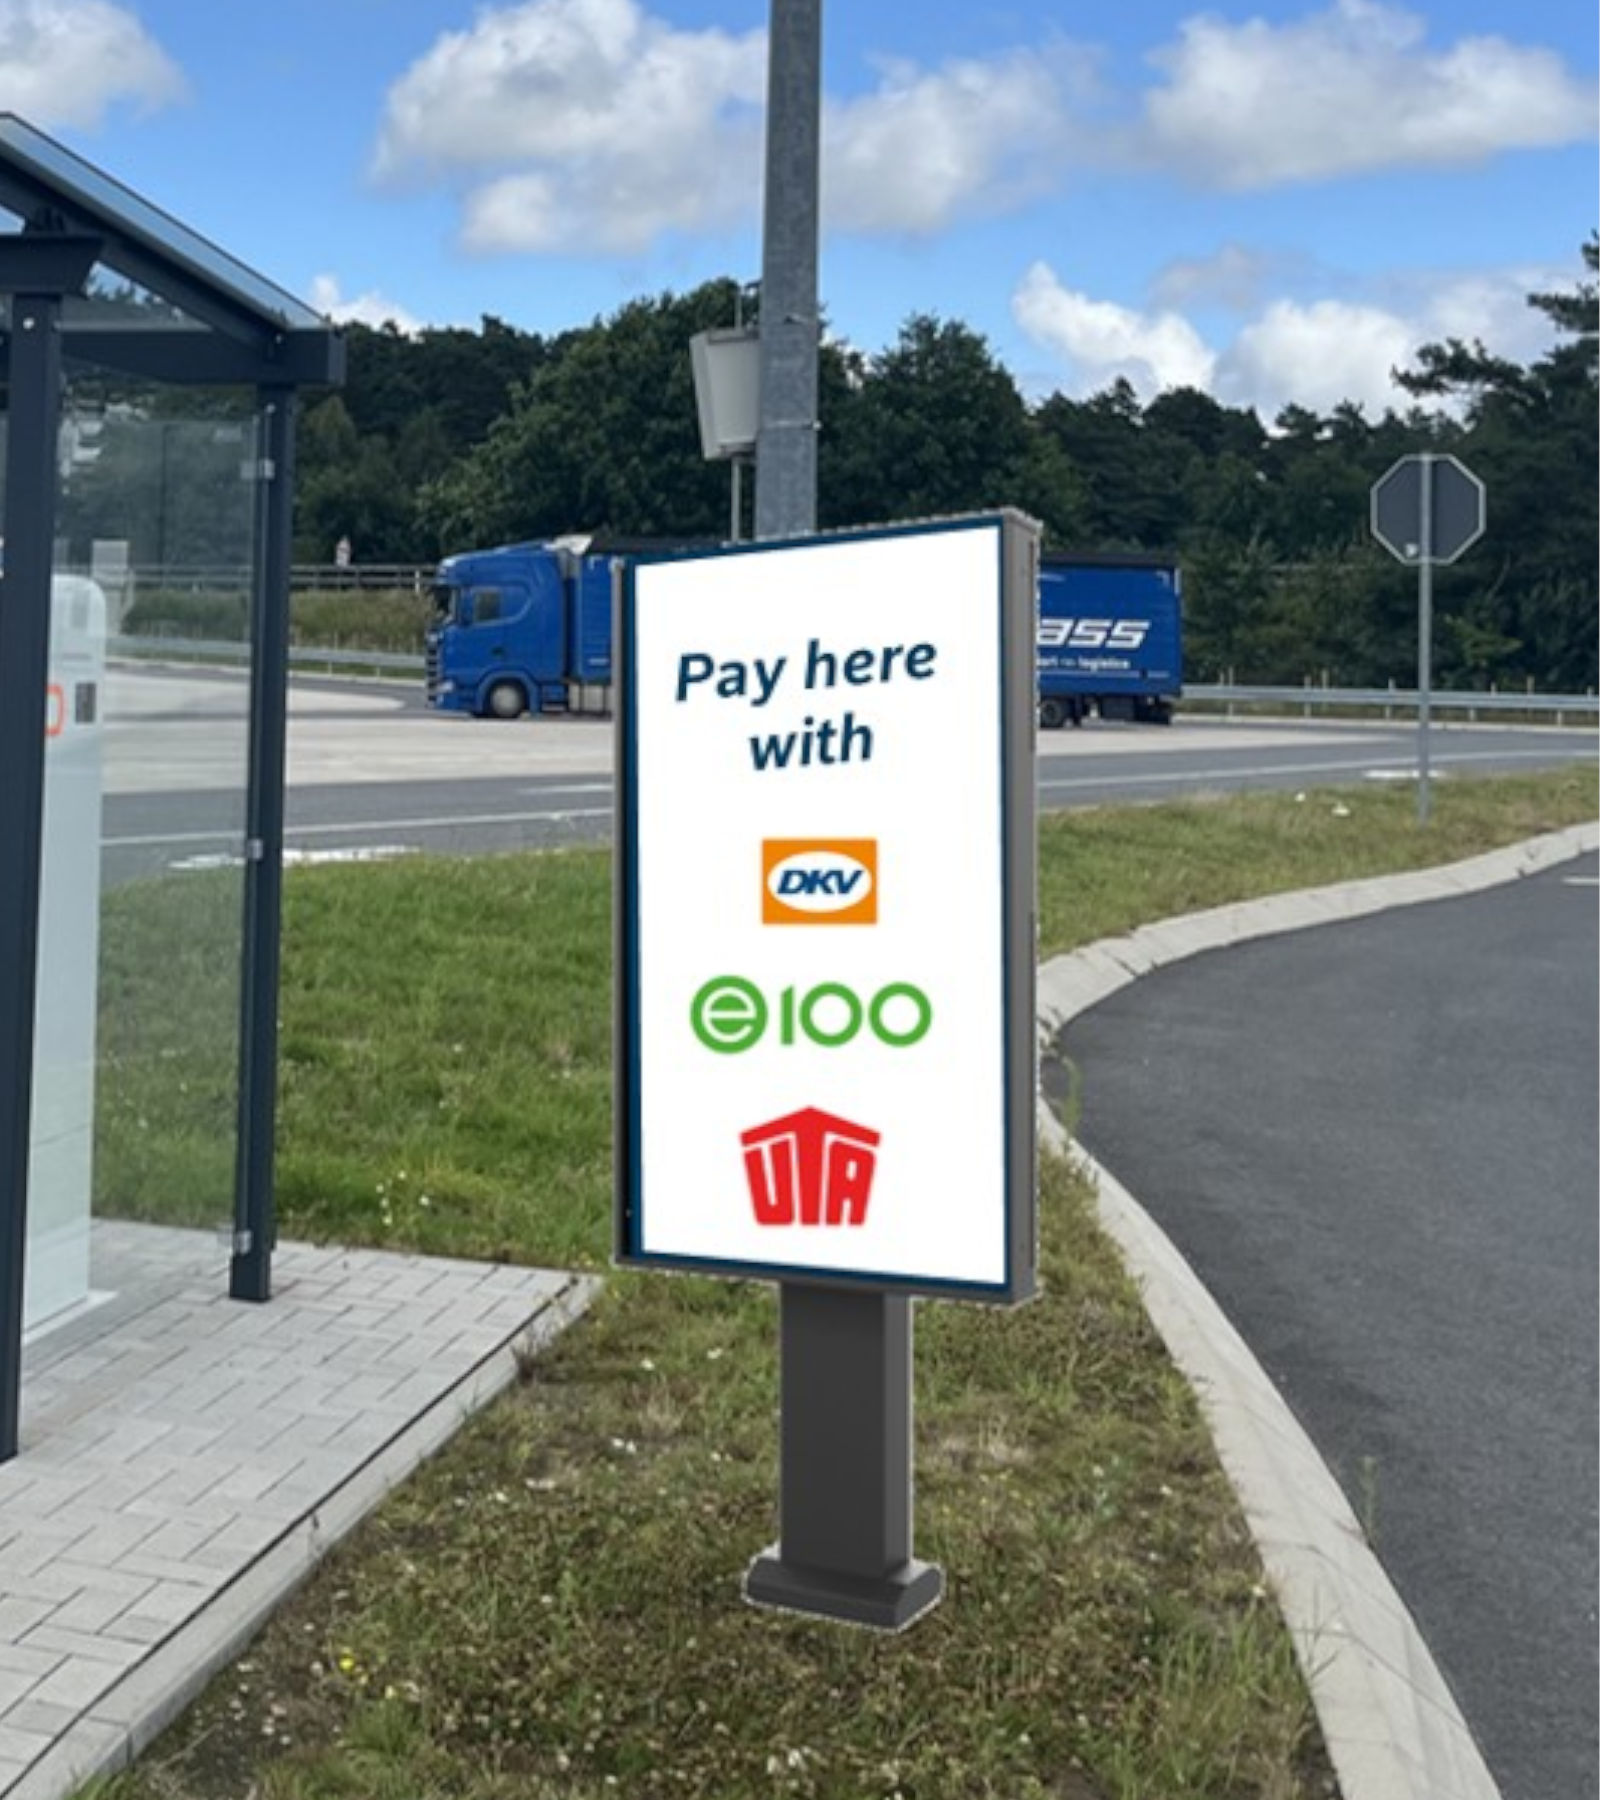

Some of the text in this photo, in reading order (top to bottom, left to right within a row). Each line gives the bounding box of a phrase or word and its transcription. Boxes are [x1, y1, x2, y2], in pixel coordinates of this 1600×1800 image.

[675, 638, 937, 708] Pay here
[749, 711, 874, 771] with
[776, 869, 864, 895] DKV
[738, 1105, 882, 1227] UTA
